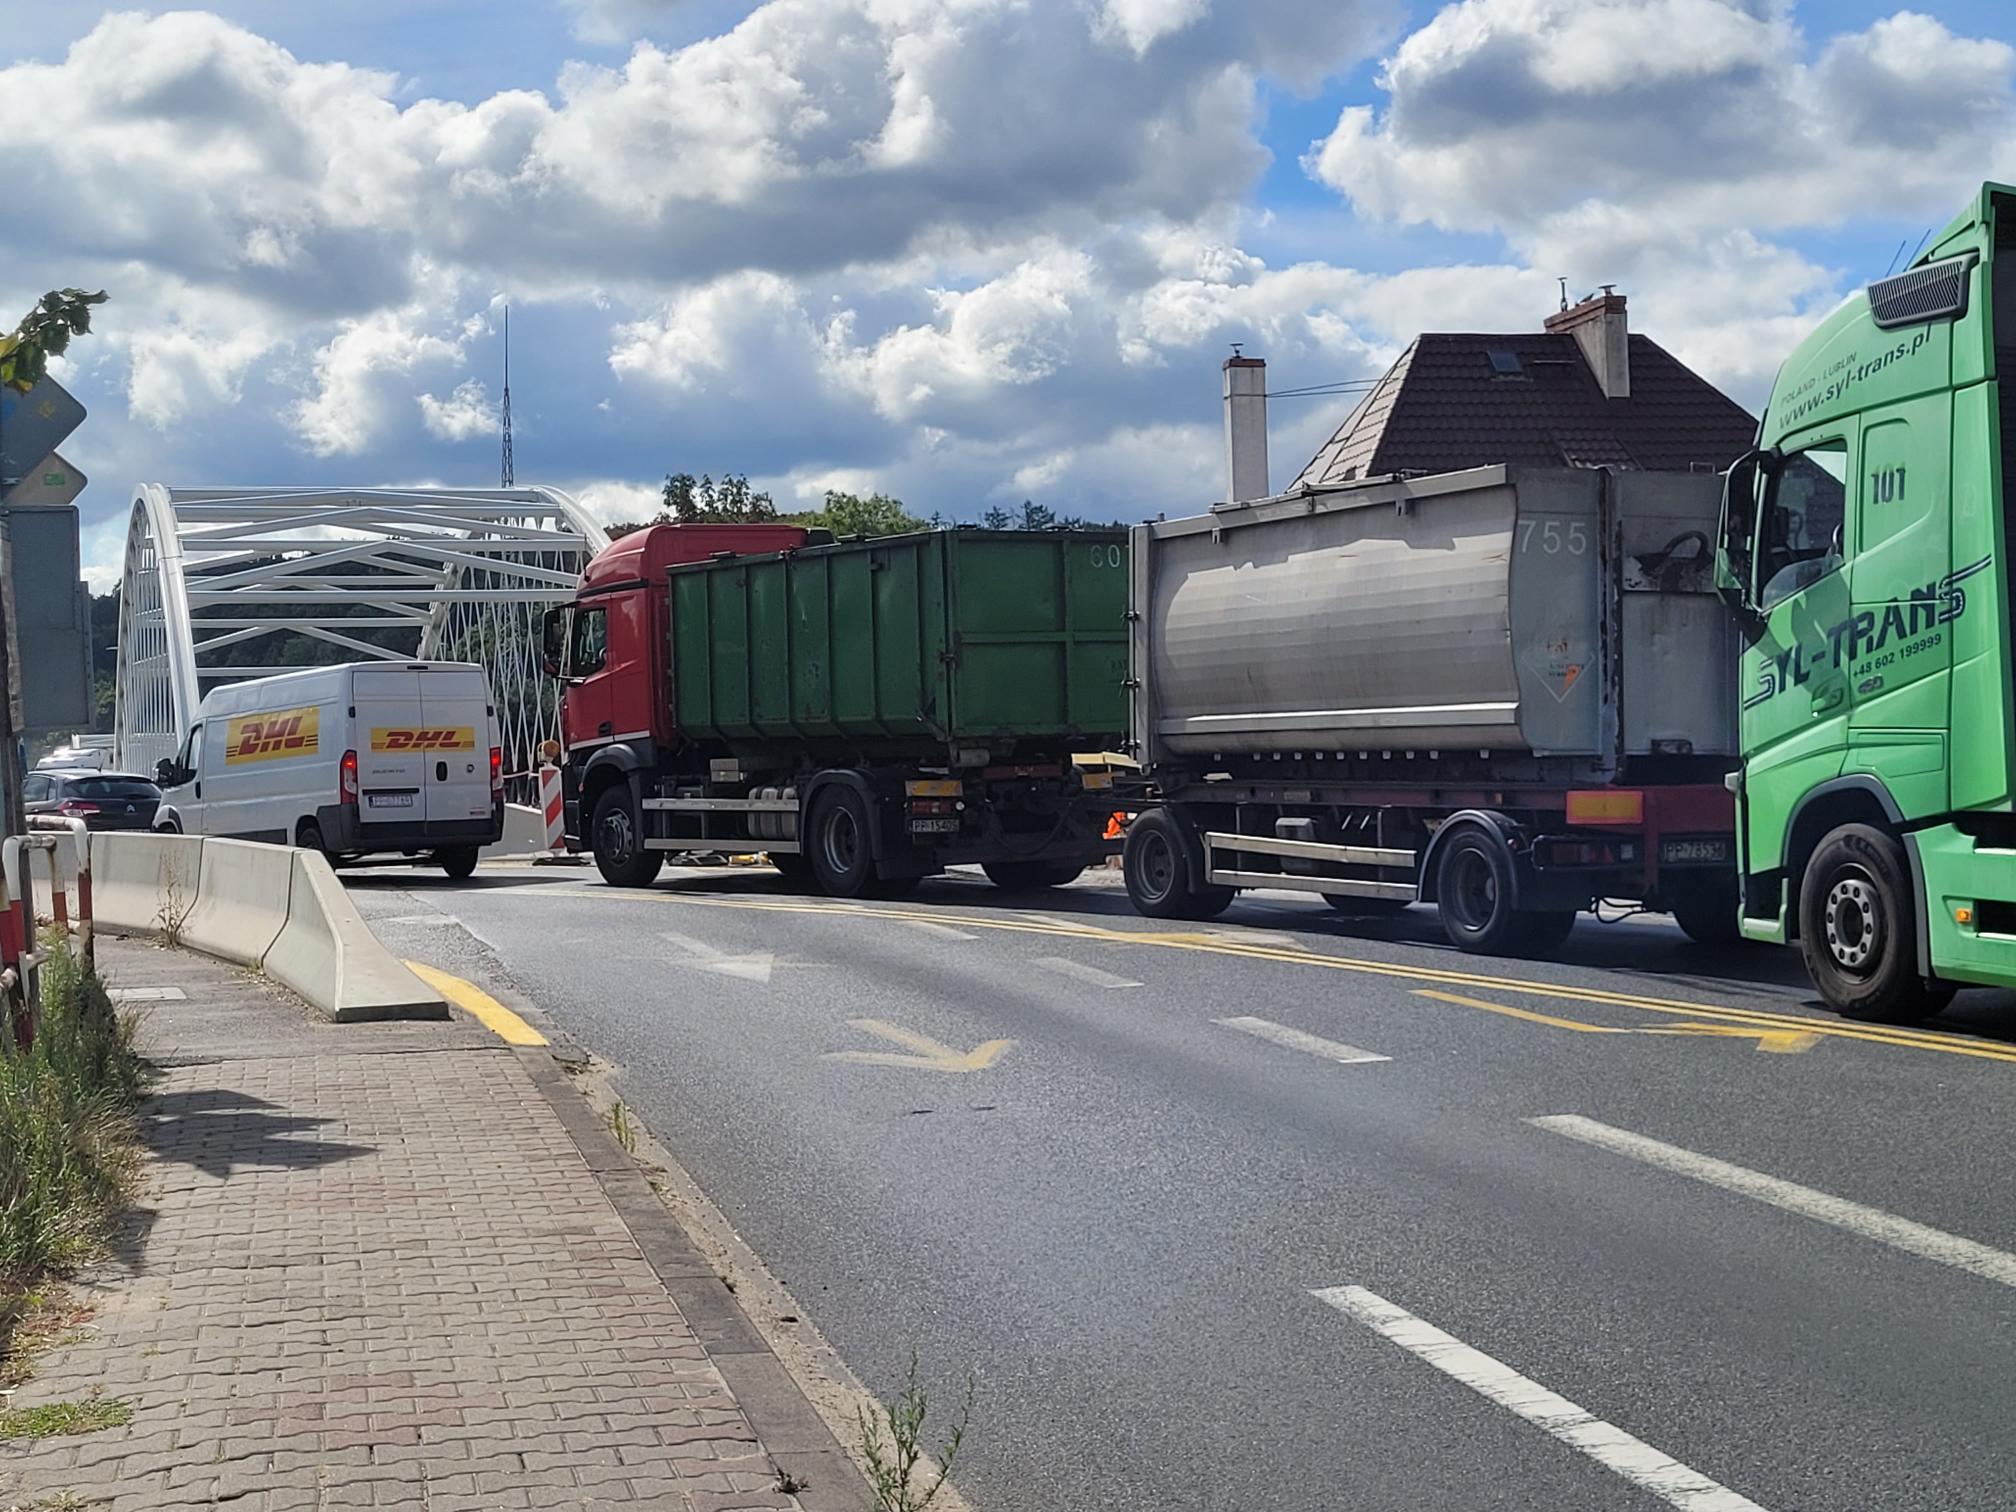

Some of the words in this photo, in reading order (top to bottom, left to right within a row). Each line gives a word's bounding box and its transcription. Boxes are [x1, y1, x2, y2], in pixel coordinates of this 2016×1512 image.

[1779, 322, 1932, 430] www.syl-trans.pl
[1823, 352, 1858, 380] LUBLIN
[1871, 467, 1906, 505] 101
[1091, 544, 1130, 568] 60
[1518, 520, 1587, 555] 755
[1744, 555, 1991, 711] SYL-TRANS
[1853, 661, 1872, 678] +48
[1875, 651, 1896, 670] 602
[1900, 633, 1942, 659] 199999
[238, 715, 307, 756] DHL
[386, 730, 462, 749] DHL
